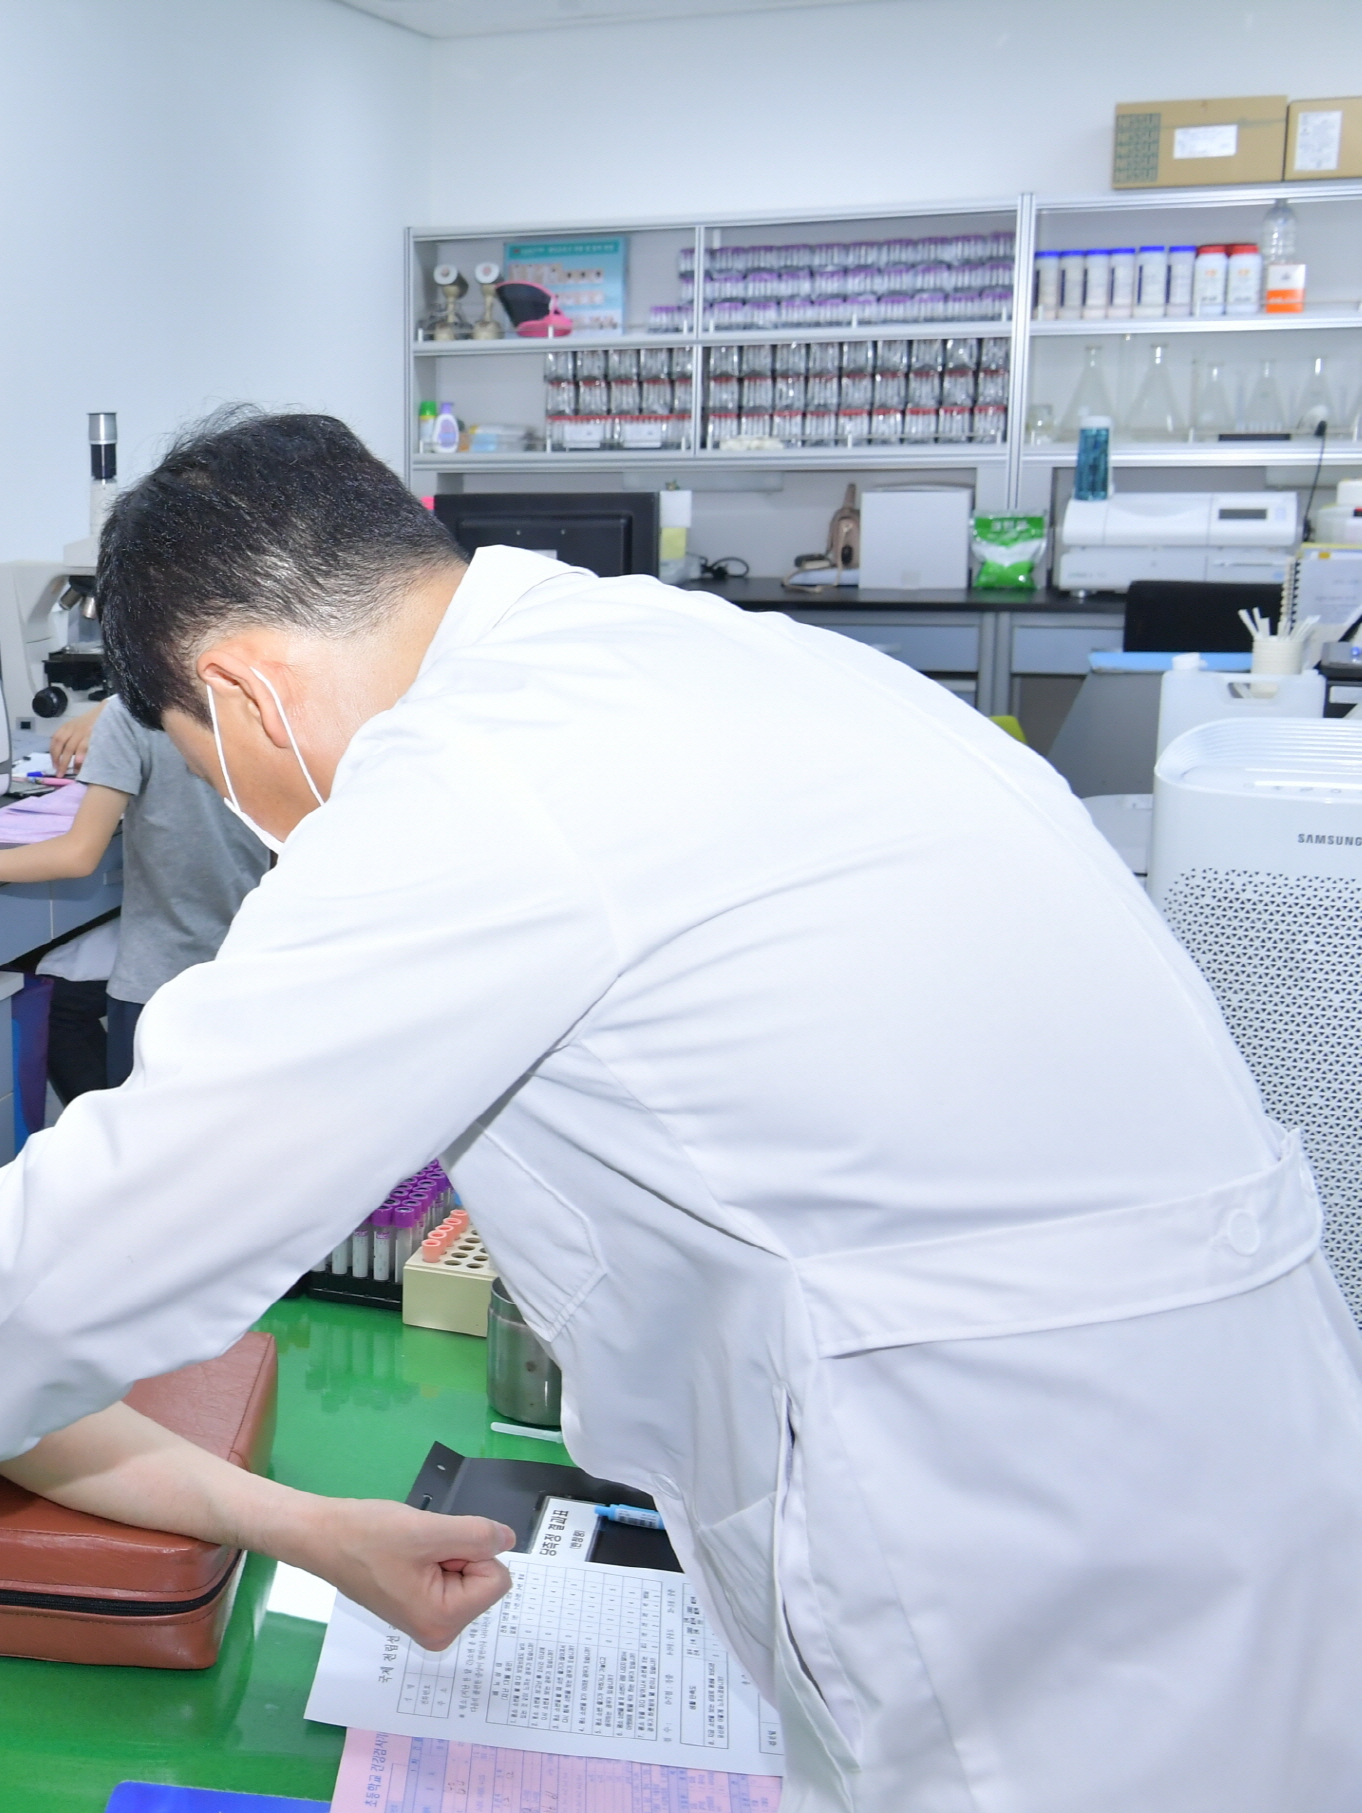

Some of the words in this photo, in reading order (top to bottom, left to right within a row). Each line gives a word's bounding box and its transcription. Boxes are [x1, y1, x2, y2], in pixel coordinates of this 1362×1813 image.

[1297, 833, 1362, 847] SAMSUNG
[548, 1509, 569, 1530] 결과표
[539, 1533, 561, 1556] 당측정
[382, 1634, 400, 1661] 전립선
[377, 1665, 394, 1683] 국제
[371, 1732, 389, 1771] 건강검사기
[364, 1774, 381, 1806] 초등학교
